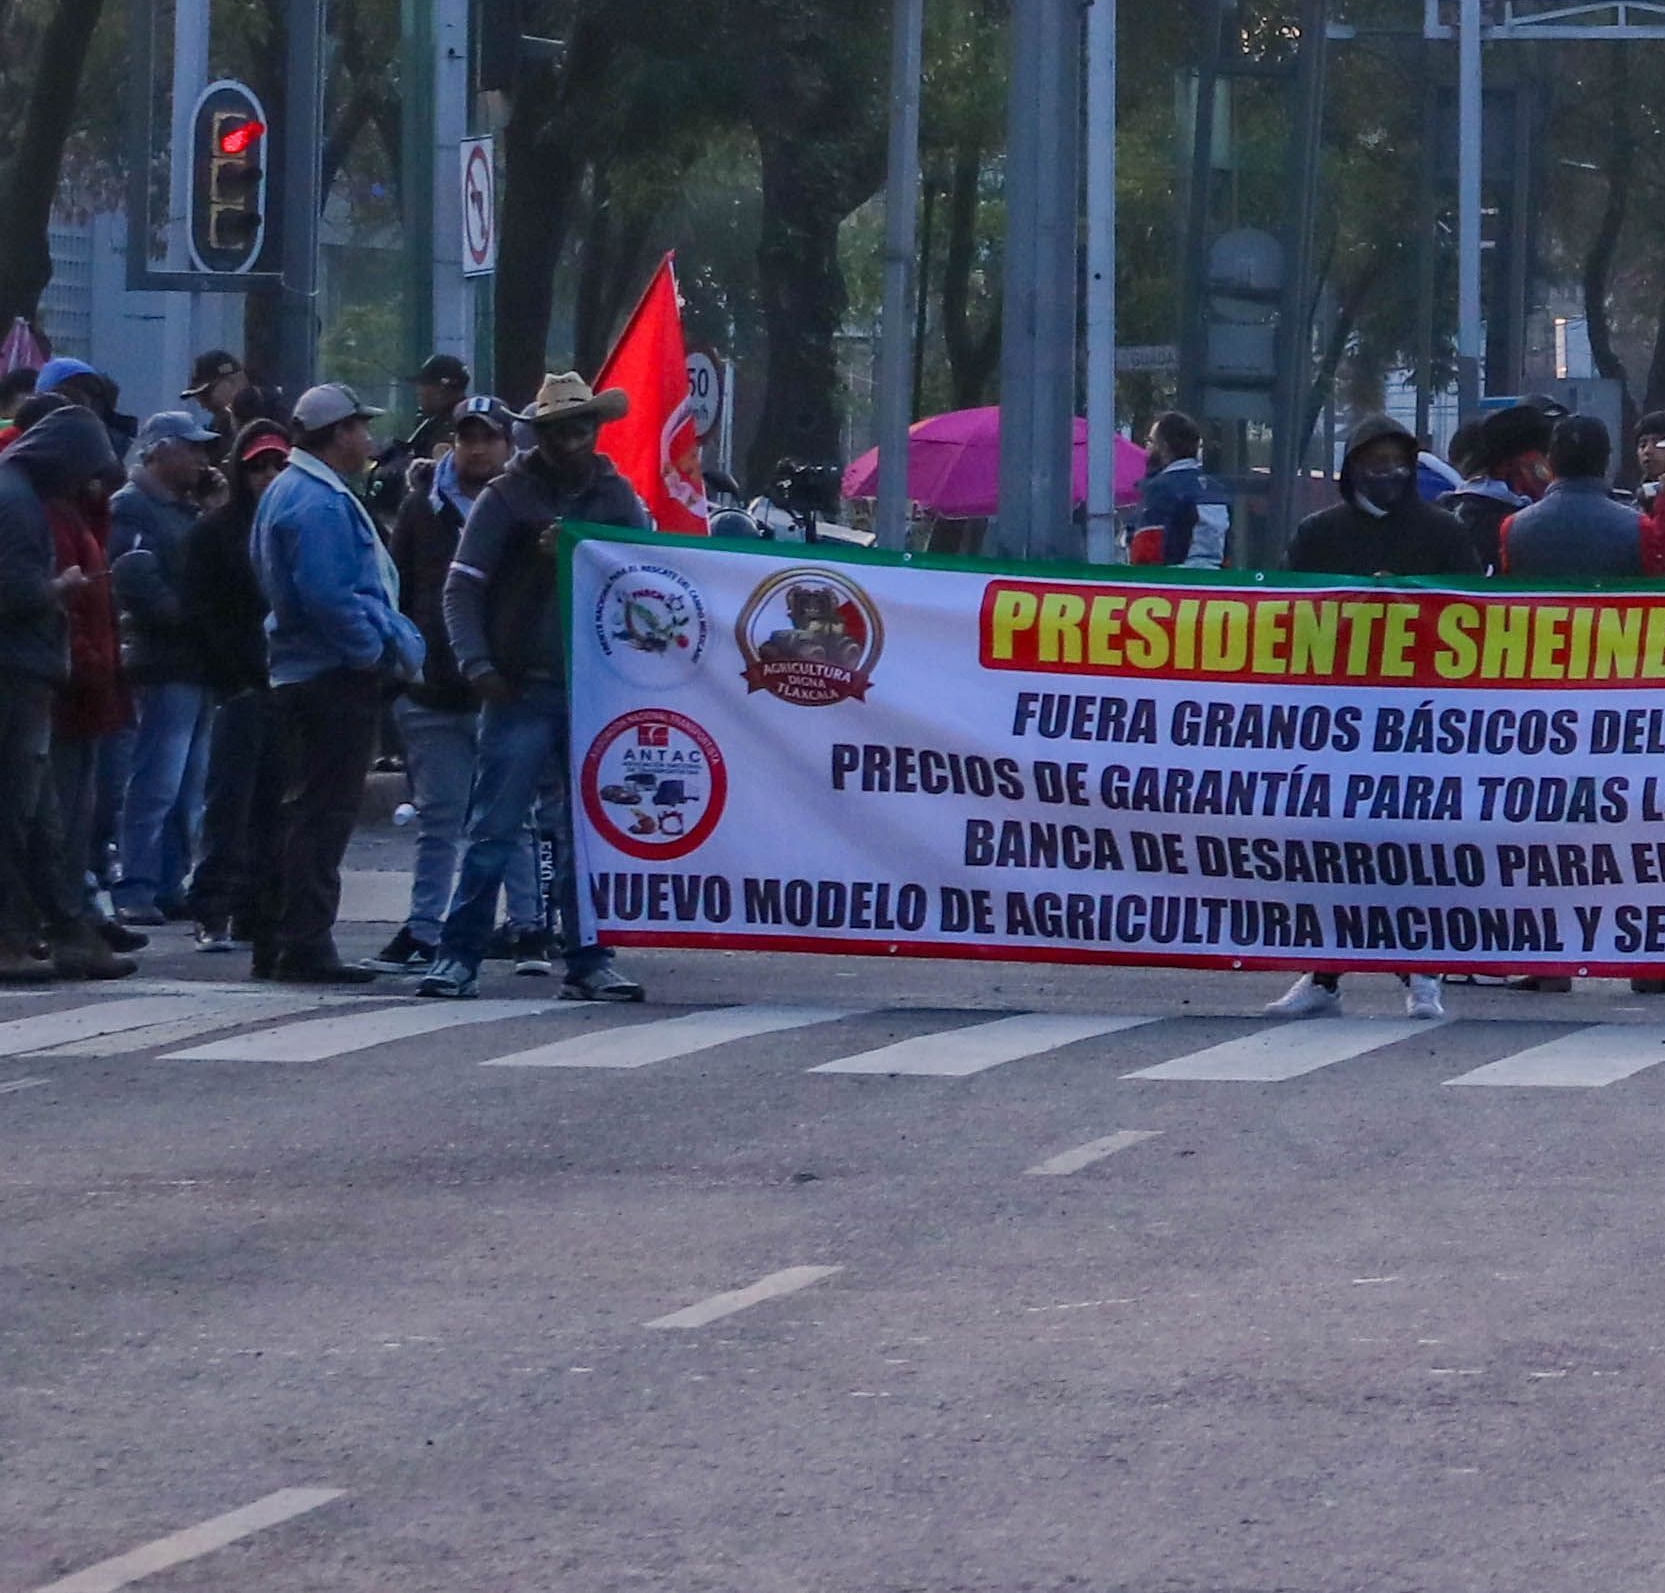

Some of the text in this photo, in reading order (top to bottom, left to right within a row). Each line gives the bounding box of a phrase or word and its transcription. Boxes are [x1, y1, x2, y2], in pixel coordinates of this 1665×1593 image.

[687, 368, 709, 398] 50
[992, 589, 1420, 677] PRESIDENTE
[763, 663, 851, 683] AGRICULTURA
[777, 682, 839, 700] TLAXCALA
[788, 675, 826, 688] DIGNA
[1012, 692, 1158, 744] FUERA
[1171, 701, 1361, 752] GRANOS
[1373, 699, 1578, 755] BÁSICOS
[624, 748, 702, 763] ANTAC
[832, 743, 1024, 801] PRECIOS
[1034, 760, 1091, 806] DE
[1101, 763, 1331, 818] GARANTÍA
[1343, 774, 1463, 820] PARA
[1478, 776, 1629, 823] TODAS
[964, 819, 1124, 872] BANCA
[1129, 831, 1189, 874] DE
[1196, 835, 1485, 887] DESARROLLO
[1496, 842, 1623, 887] PARA
[590, 872, 732, 923] NUEVO
[743, 877, 928, 931] MODELO
[940, 886, 995, 934] DE
[1005, 890, 1323, 948] AGRICULTURA
[1334, 904, 1564, 952] NACIONAL
[1579, 907, 1604, 952] Y
